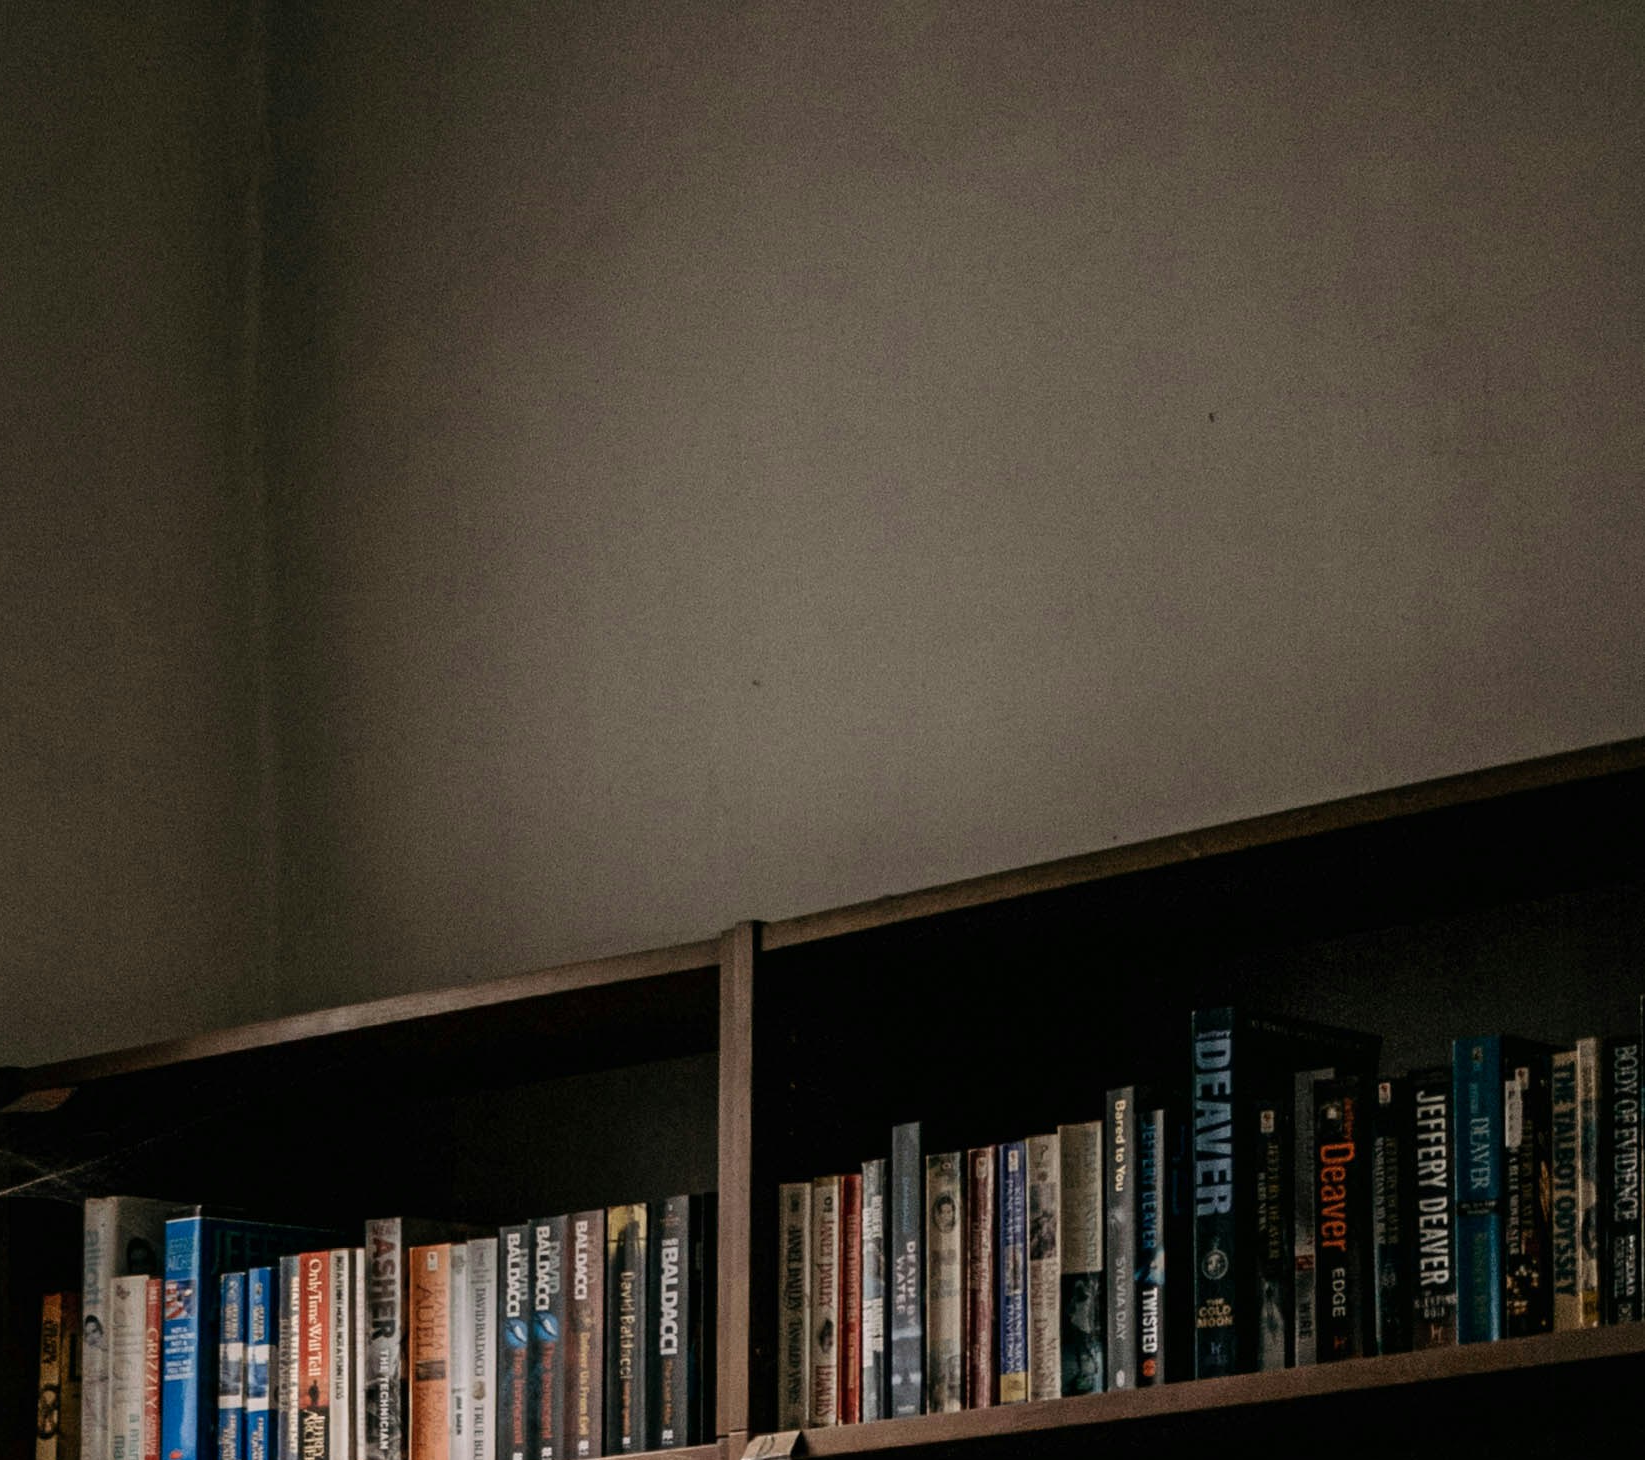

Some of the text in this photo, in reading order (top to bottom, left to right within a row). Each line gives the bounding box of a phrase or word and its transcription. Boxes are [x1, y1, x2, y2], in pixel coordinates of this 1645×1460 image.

[1195, 1040, 1233, 1216] DEAVER
[1469, 1116, 1491, 1190] DEAVER
[1555, 1063, 1576, 1296] THE TALBOT ODYSSEY
[1613, 1044, 1638, 1222] BODY OF EVIDENCE
[1318, 1142, 1356, 1318] Deaver EDGE
[1415, 1091, 1449, 1286] JEFFERY DEAVER
[308, 1258, 322, 1376] Only Time Will Tell
[506, 1233, 521, 1318] BALDACCI
[535, 1226, 551, 1311] BALDACCI
[574, 1220, 588, 1300] BALDACCI
[659, 1248, 679, 1355] BALDACCI
[371, 1236, 396, 1450] ASHER THE TECHNICIAN
[1141, 1287, 1158, 1353] TWISTED
